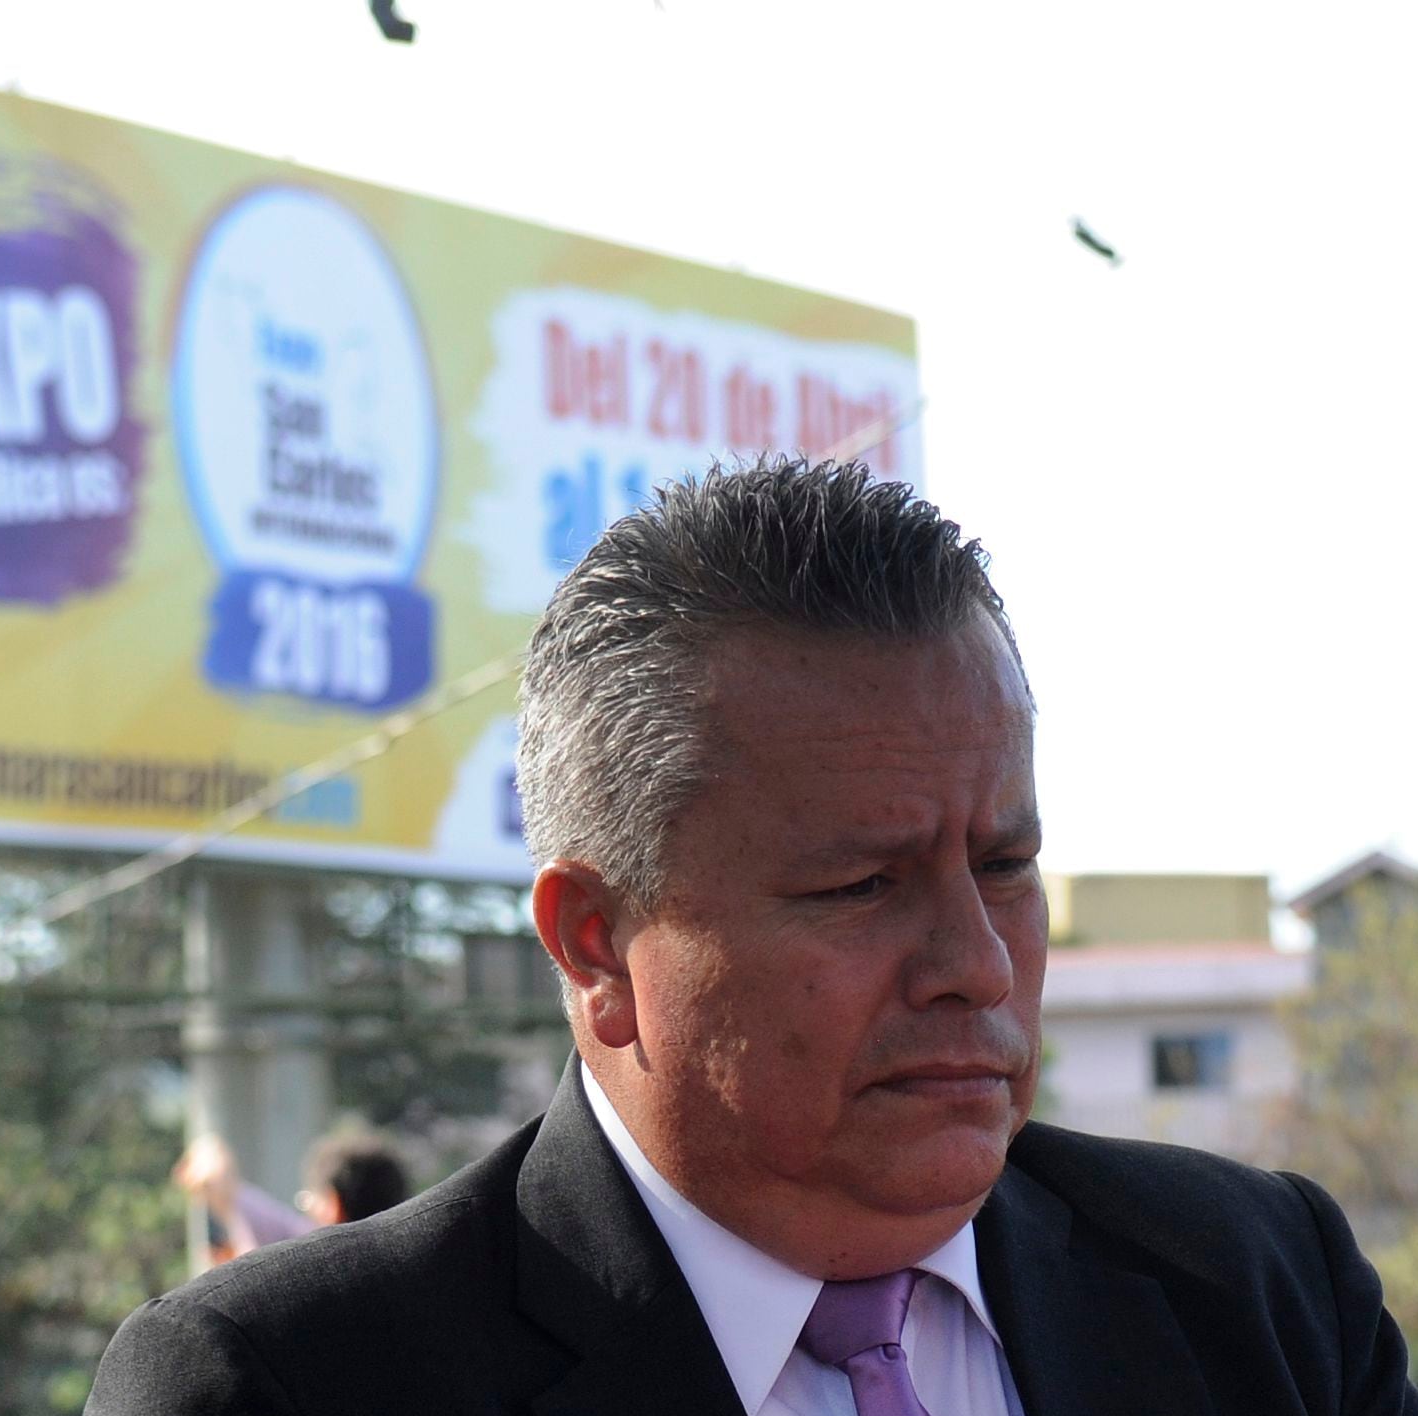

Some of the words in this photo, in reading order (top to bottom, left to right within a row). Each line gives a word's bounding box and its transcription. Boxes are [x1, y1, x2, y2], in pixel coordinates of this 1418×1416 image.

[544, 319, 629, 426] Del
[646, 338, 705, 445] 20
[725, 364, 775, 450] de
[251, 583, 392, 704] 2016
